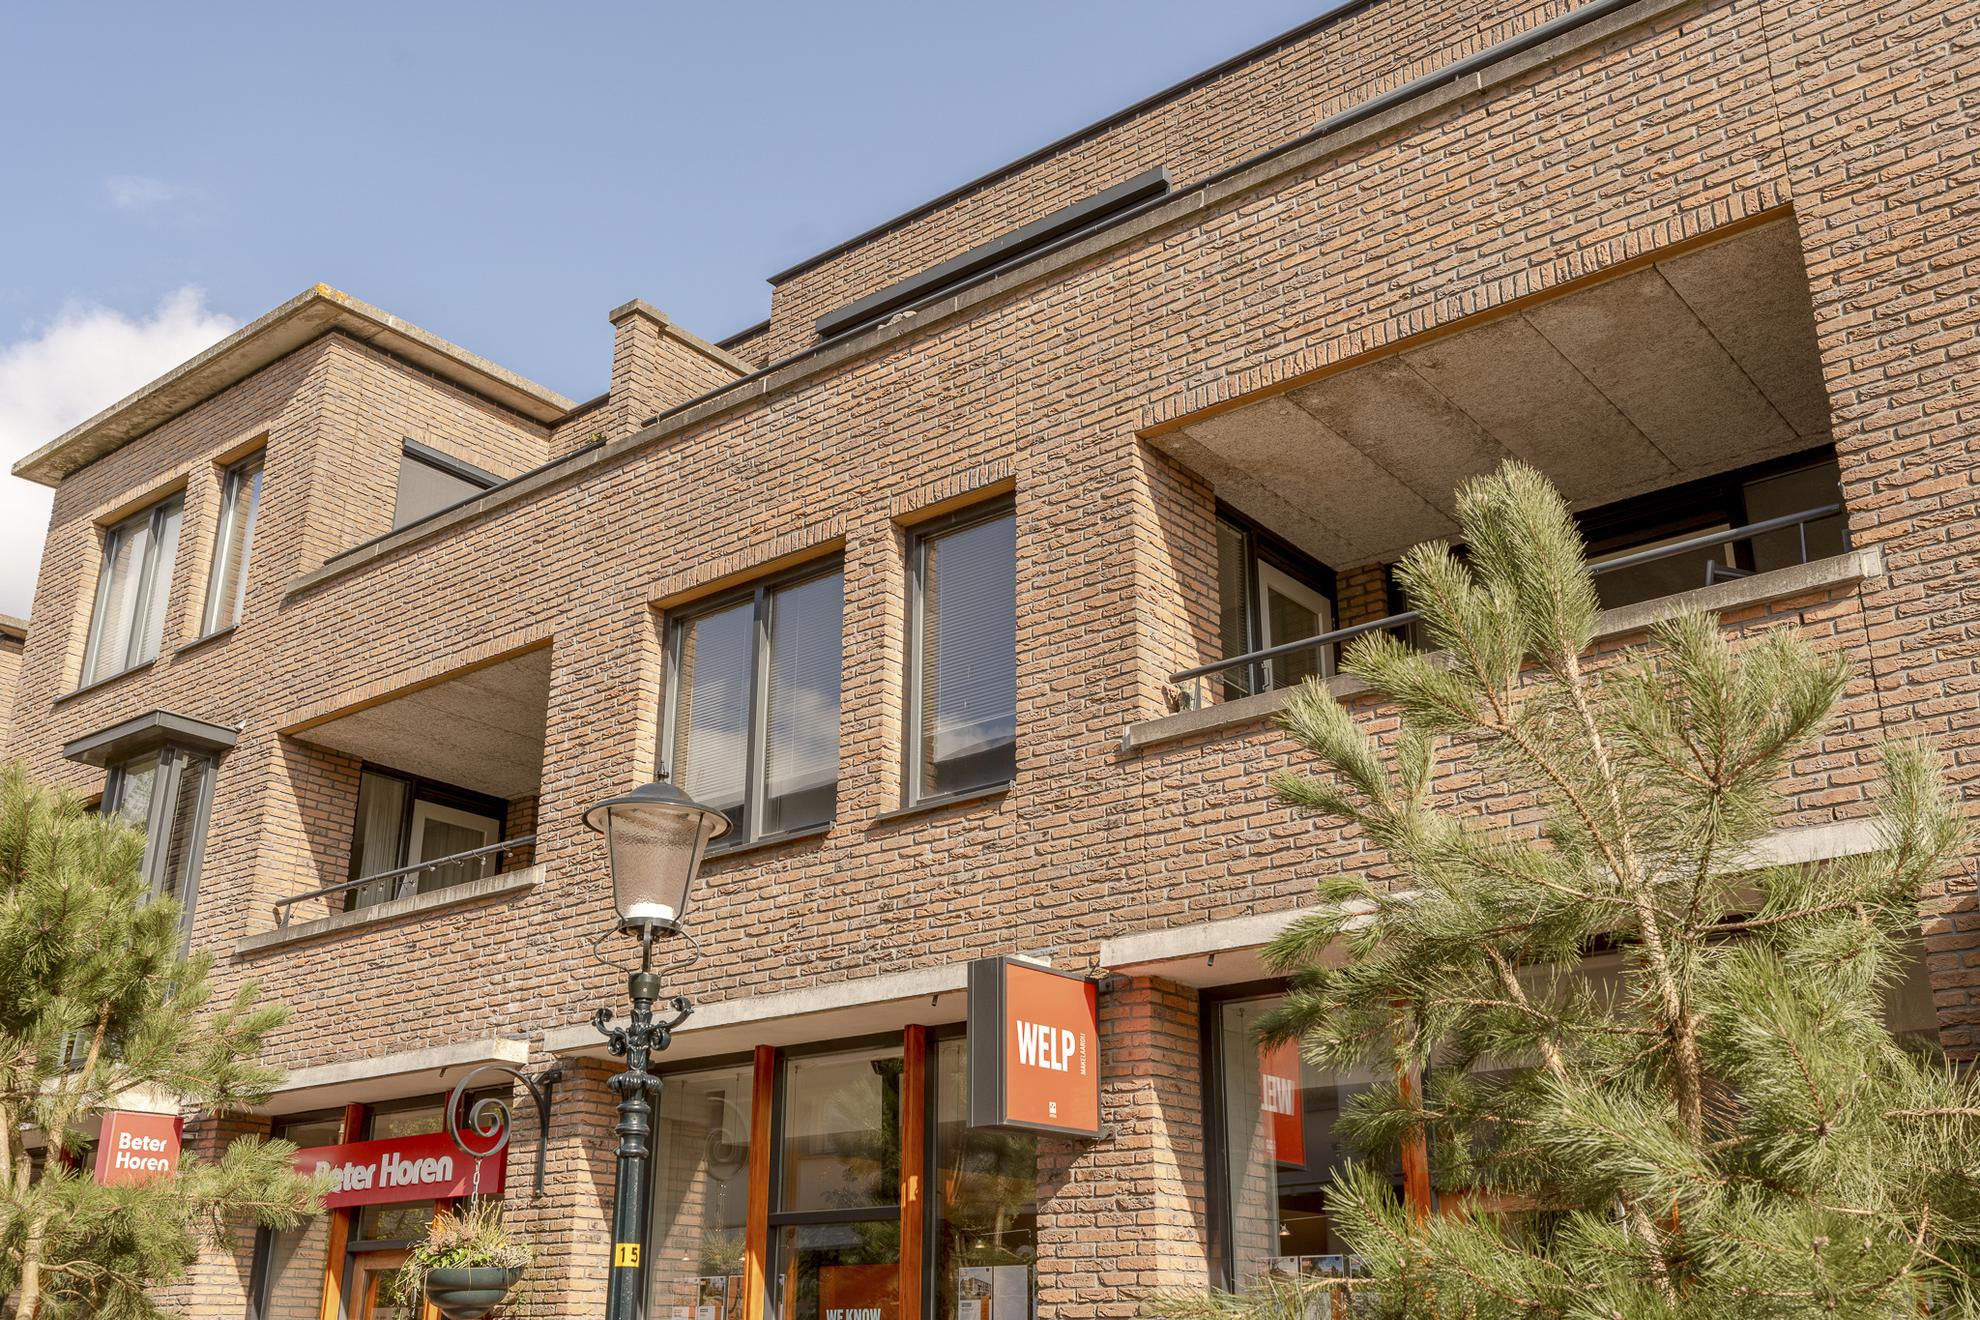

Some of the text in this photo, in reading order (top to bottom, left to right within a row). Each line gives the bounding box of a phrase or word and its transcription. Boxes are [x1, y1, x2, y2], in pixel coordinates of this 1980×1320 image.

[1016, 1019, 1076, 1072] WELP
[119, 1131, 167, 1152] Beter
[115, 1151, 169, 1171] Horen
[379, 1152, 453, 1188] Horen
[620, 1246, 638, 1263] 15
[826, 1308, 881, 1320] WE KNOW
